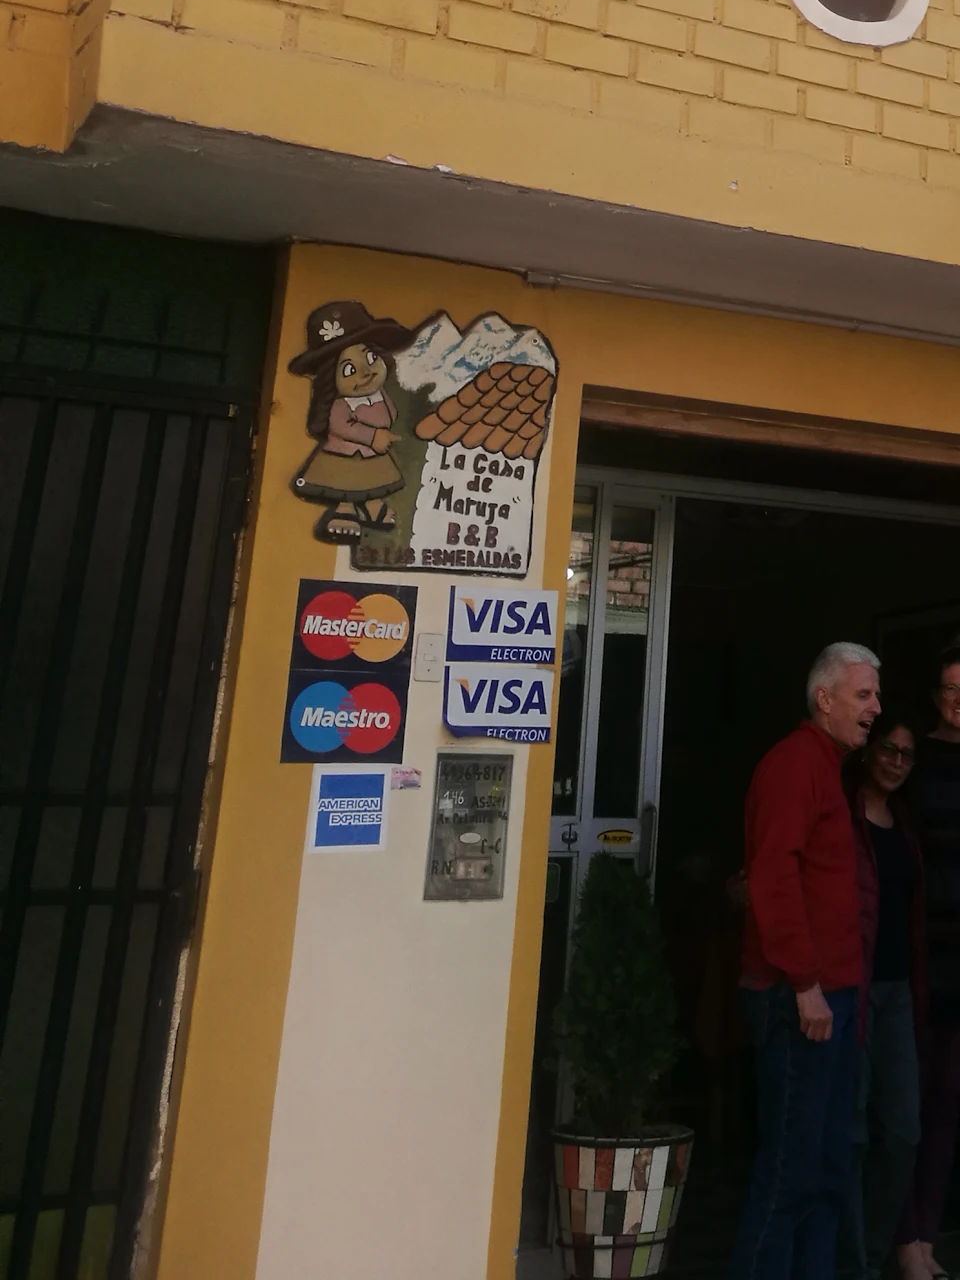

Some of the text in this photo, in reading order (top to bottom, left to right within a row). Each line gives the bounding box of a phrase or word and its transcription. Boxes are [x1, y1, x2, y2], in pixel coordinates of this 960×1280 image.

[440, 446, 466, 470] La
[466, 475, 493, 493] de
[422, 548, 522, 569] ESMERALDAS
[460, 597, 552, 636] VISA
[302, 615, 407, 640] MasterCard
[490, 648, 552, 662] ELECTRON
[456, 678, 548, 715] VISA
[300, 707, 391, 729] Maestro
[318, 798, 380, 810] AMERICAN
[330, 813, 382, 825] EXPRESS
